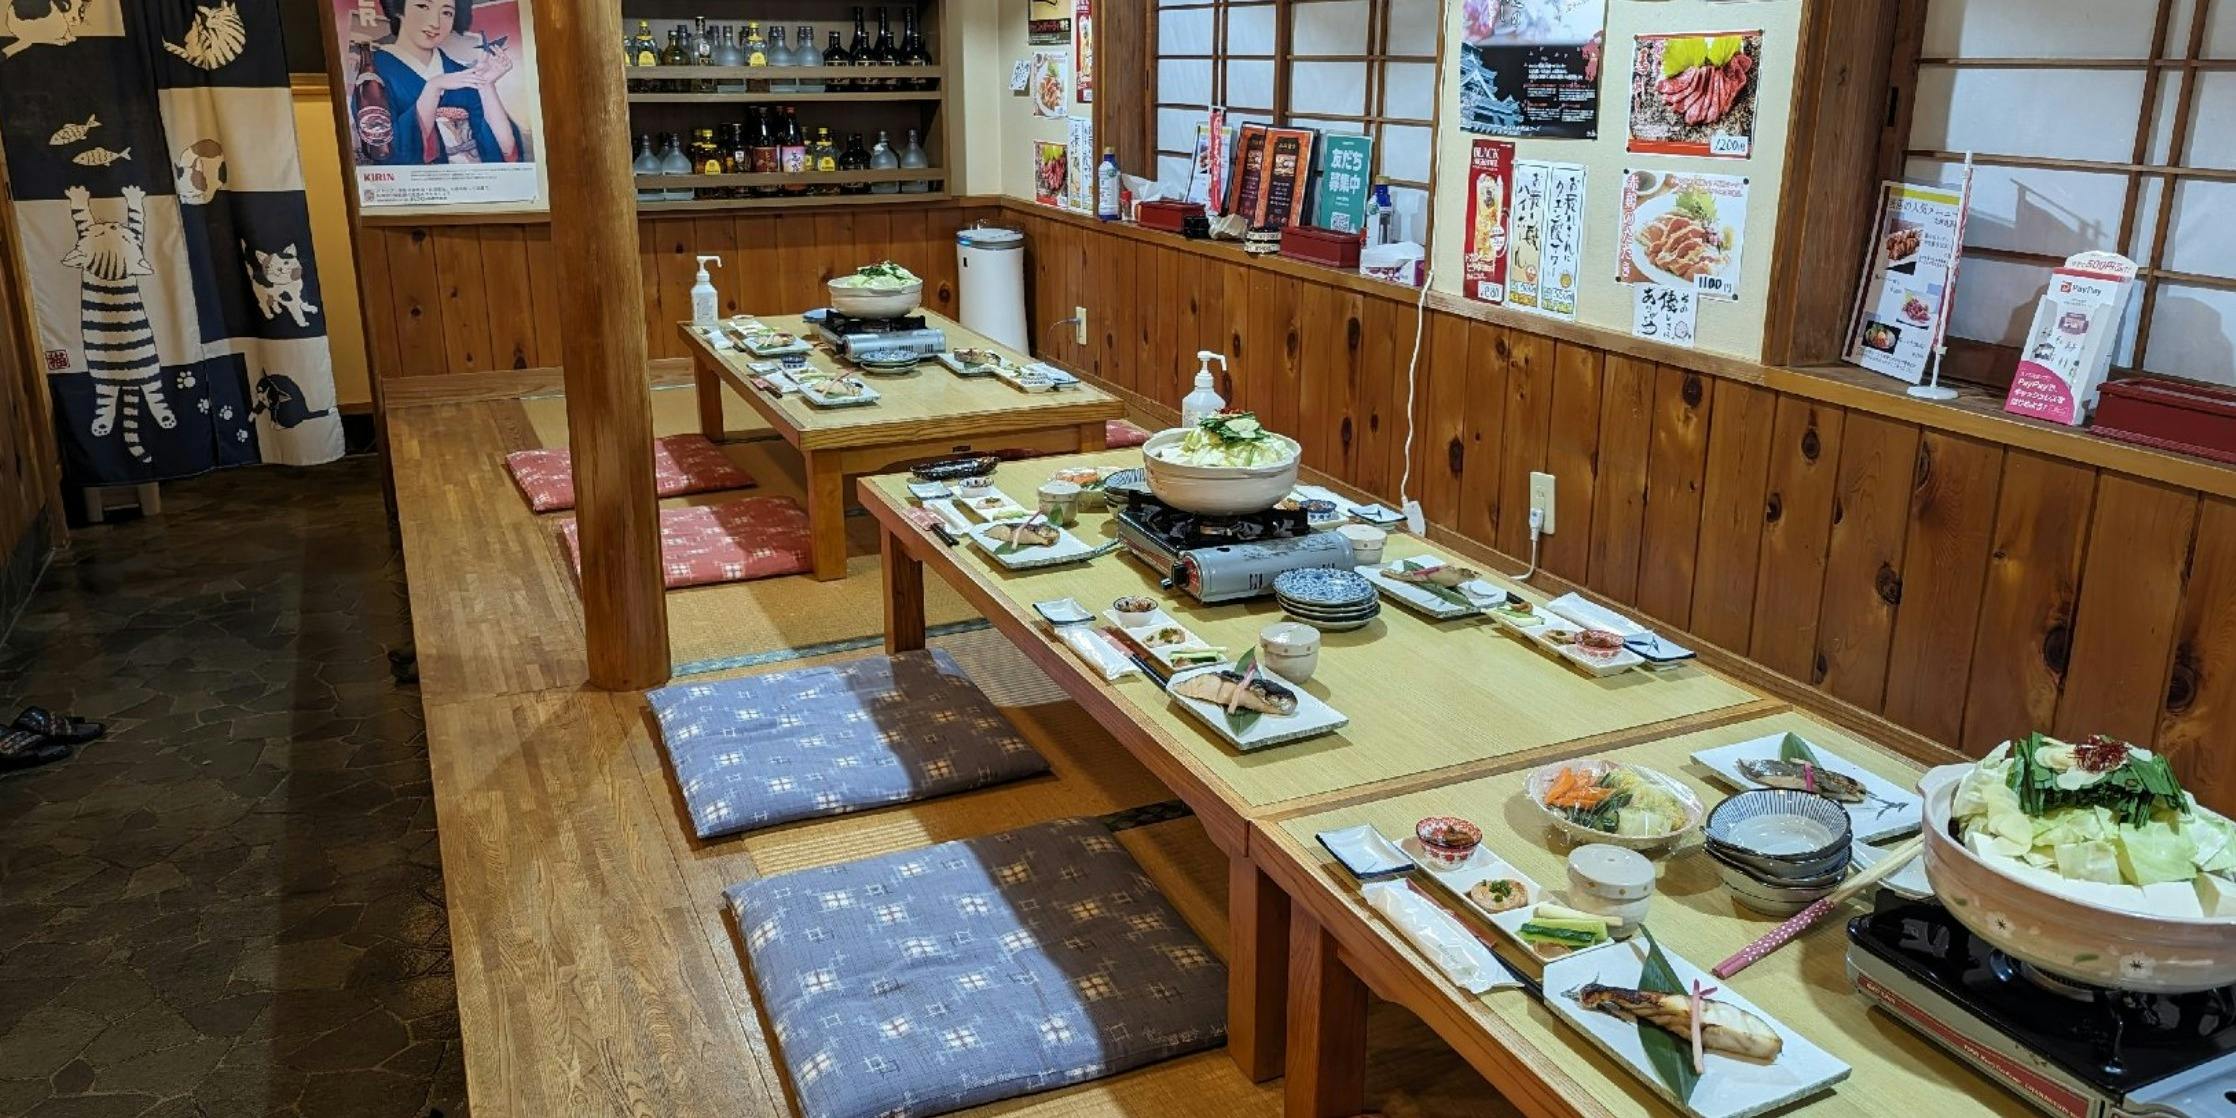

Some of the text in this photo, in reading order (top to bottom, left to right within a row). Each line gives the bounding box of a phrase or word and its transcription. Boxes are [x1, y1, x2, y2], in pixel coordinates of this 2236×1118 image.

[1331, 149, 1363, 171] 友だち
[363, 173, 395, 182] KIRIN
[1328, 172, 1361, 194] 募集中
[1698, 276, 1732, 293] 1100円
[2072, 284, 2102, 296] PayPay
